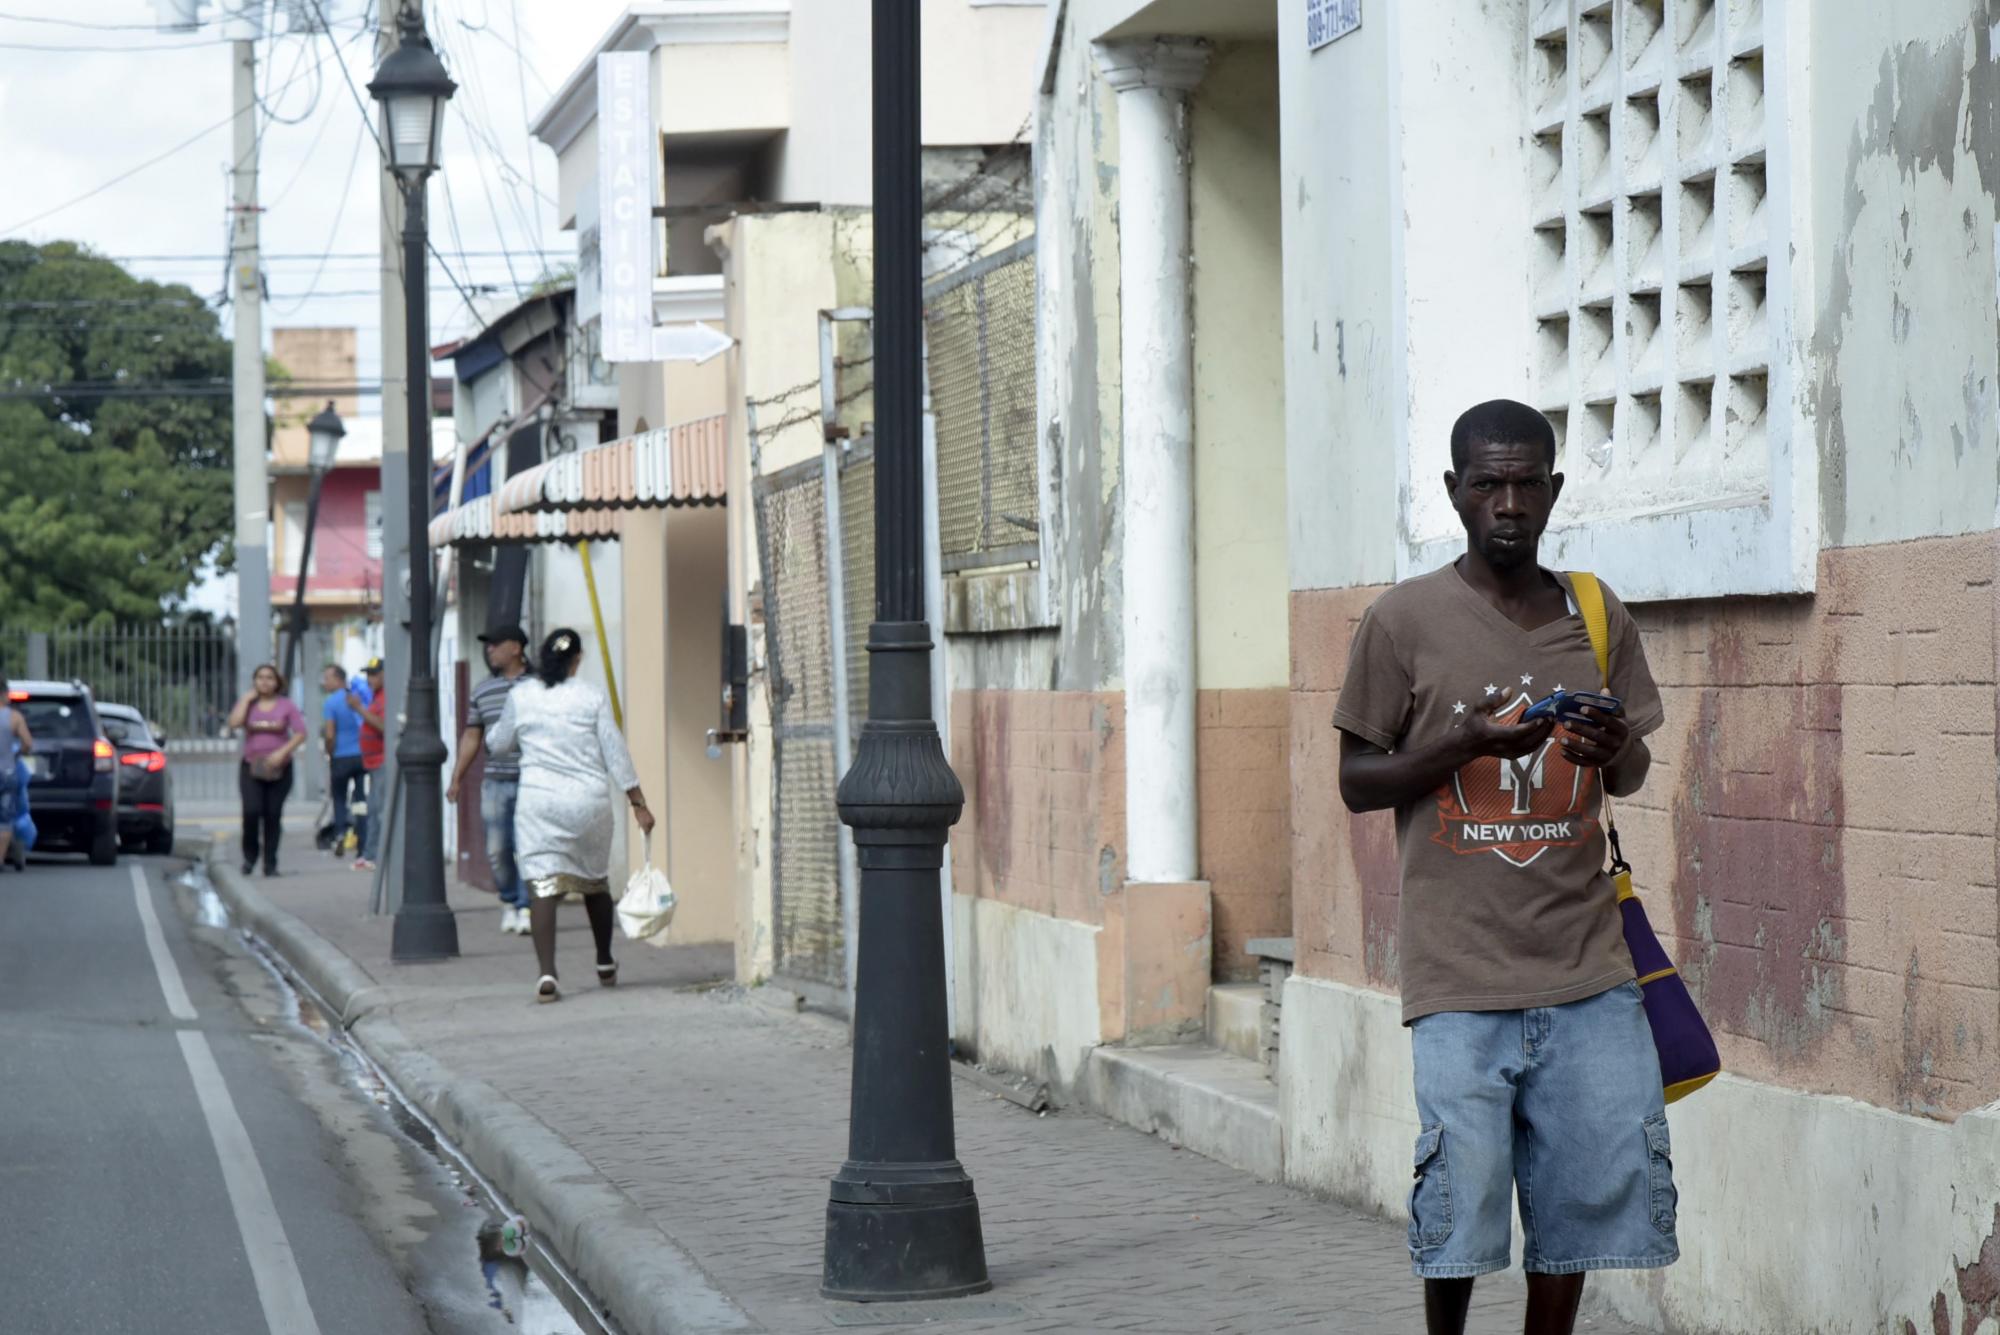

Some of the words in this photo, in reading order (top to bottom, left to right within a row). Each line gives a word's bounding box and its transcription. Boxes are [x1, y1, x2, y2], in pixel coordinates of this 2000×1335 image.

[613, 64, 635, 353] ESTACIONE
[1463, 823, 1515, 841] NEW
[1519, 822, 1572, 840] YORK
